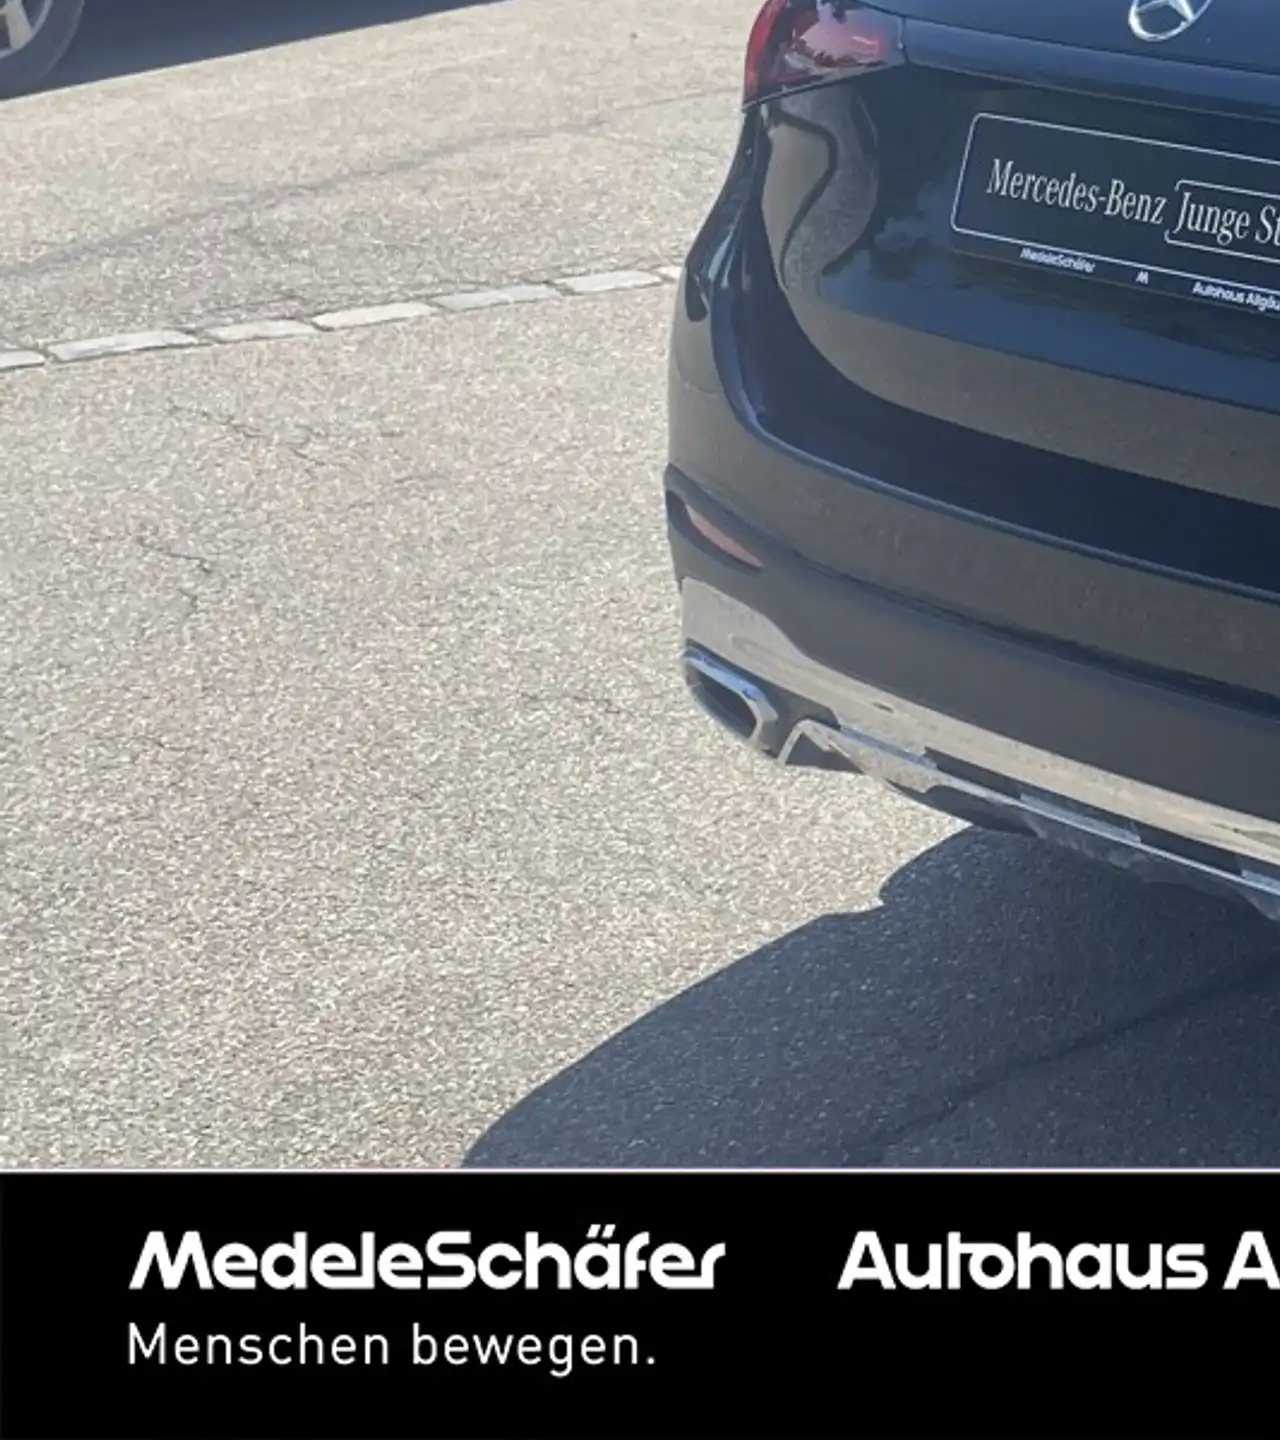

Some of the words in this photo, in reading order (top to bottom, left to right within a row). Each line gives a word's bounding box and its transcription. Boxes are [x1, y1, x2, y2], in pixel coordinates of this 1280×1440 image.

[986, 157, 1168, 225] Mercedes-Benz
[1171, 191, 1250, 246] Junge
[1192, 280, 1245, 305] Autohaus
